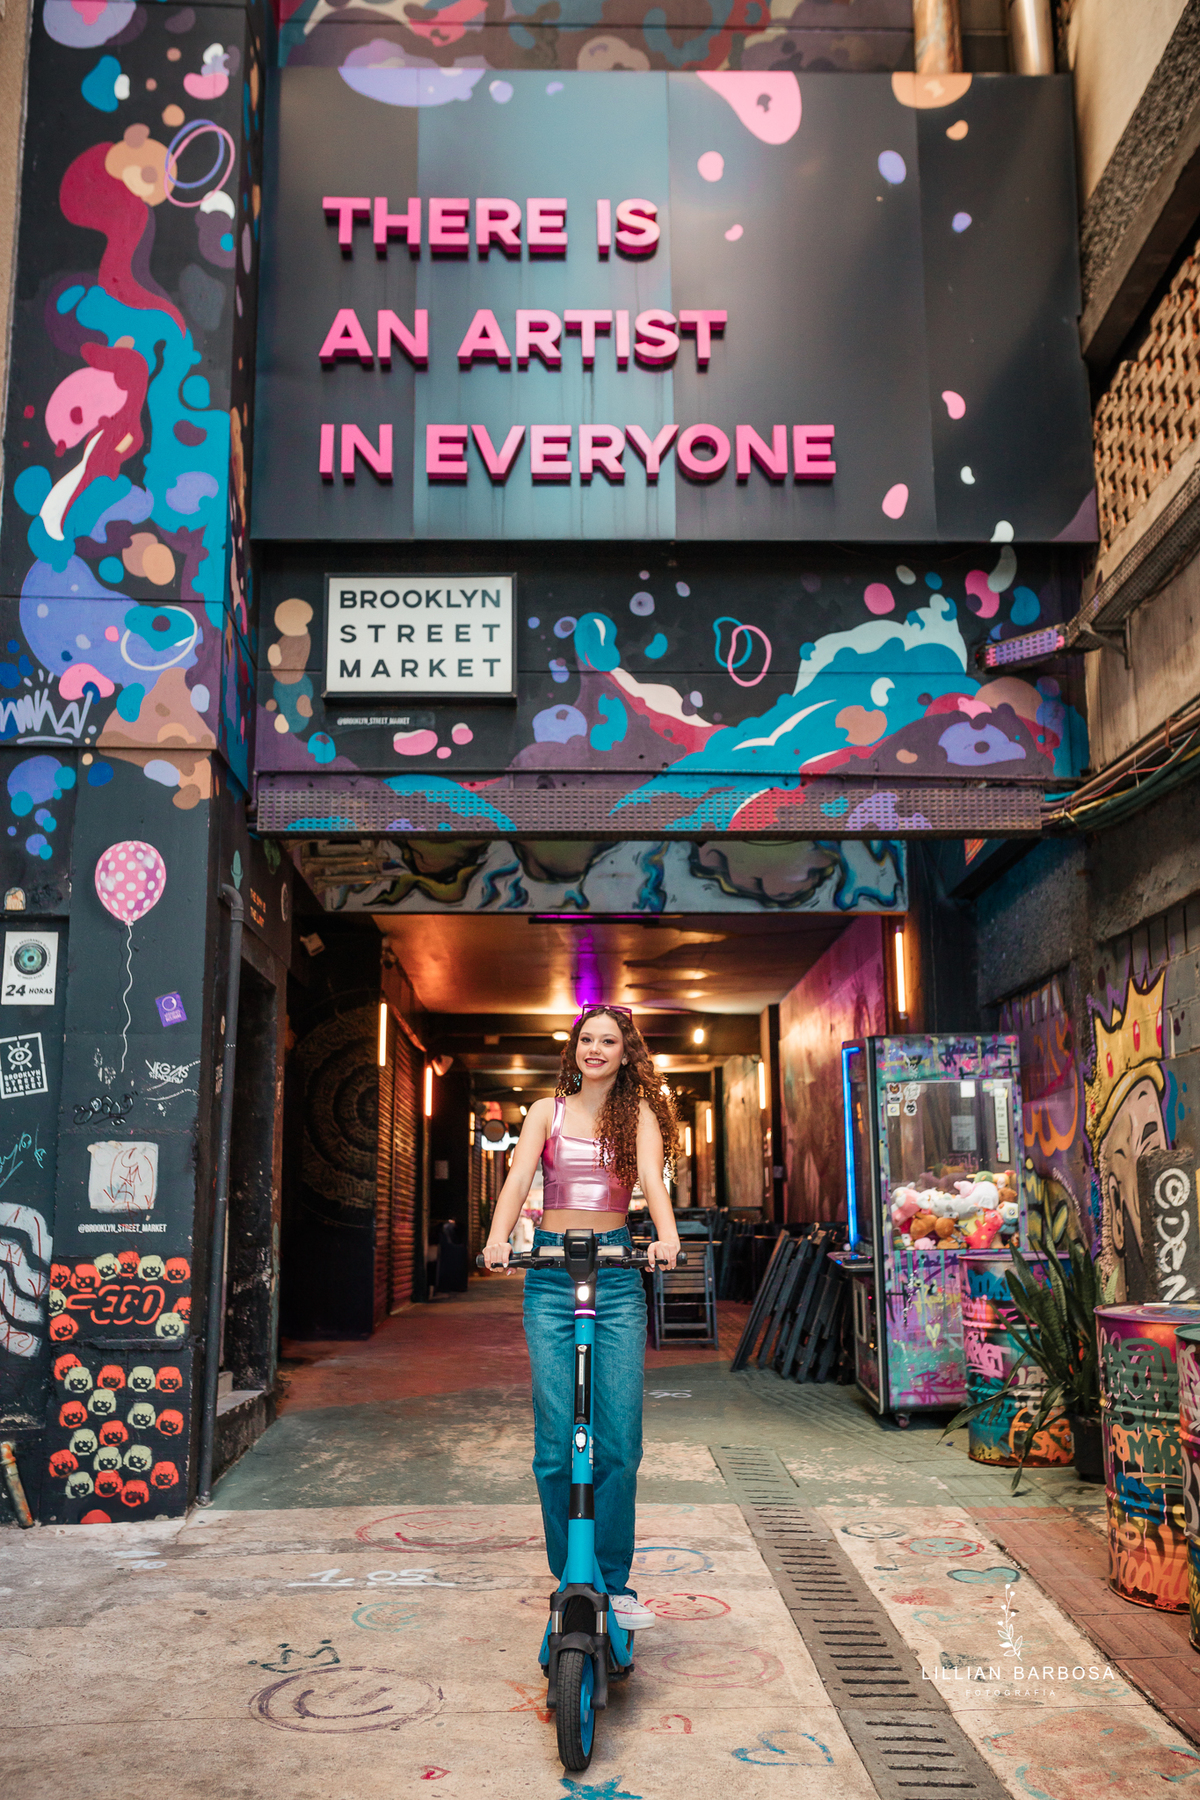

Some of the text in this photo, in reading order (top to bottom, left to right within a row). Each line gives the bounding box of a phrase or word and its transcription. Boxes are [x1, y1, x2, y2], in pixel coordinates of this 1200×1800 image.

[322, 196, 660, 256] THERE IS
[319, 308, 728, 368] AN ARTIST
[319, 423, 837, 481] IN EVERYONE
[339, 589, 502, 609] BROOKLYN
[339, 623, 501, 644] STREET
[339, 657, 502, 678] MARKET
[337, 716, 410, 726] @BROOKLYN_STREET_MARKET
[5, 984, 26, 997] 24
[4, 1069, 41, 1081] BROOKLYN
[5, 1075, 42, 1087] STREET
[5, 1081, 42, 1093] MARKET
[78, 1223, 167, 1234] @BROOKLYN_STREET_MARKET
